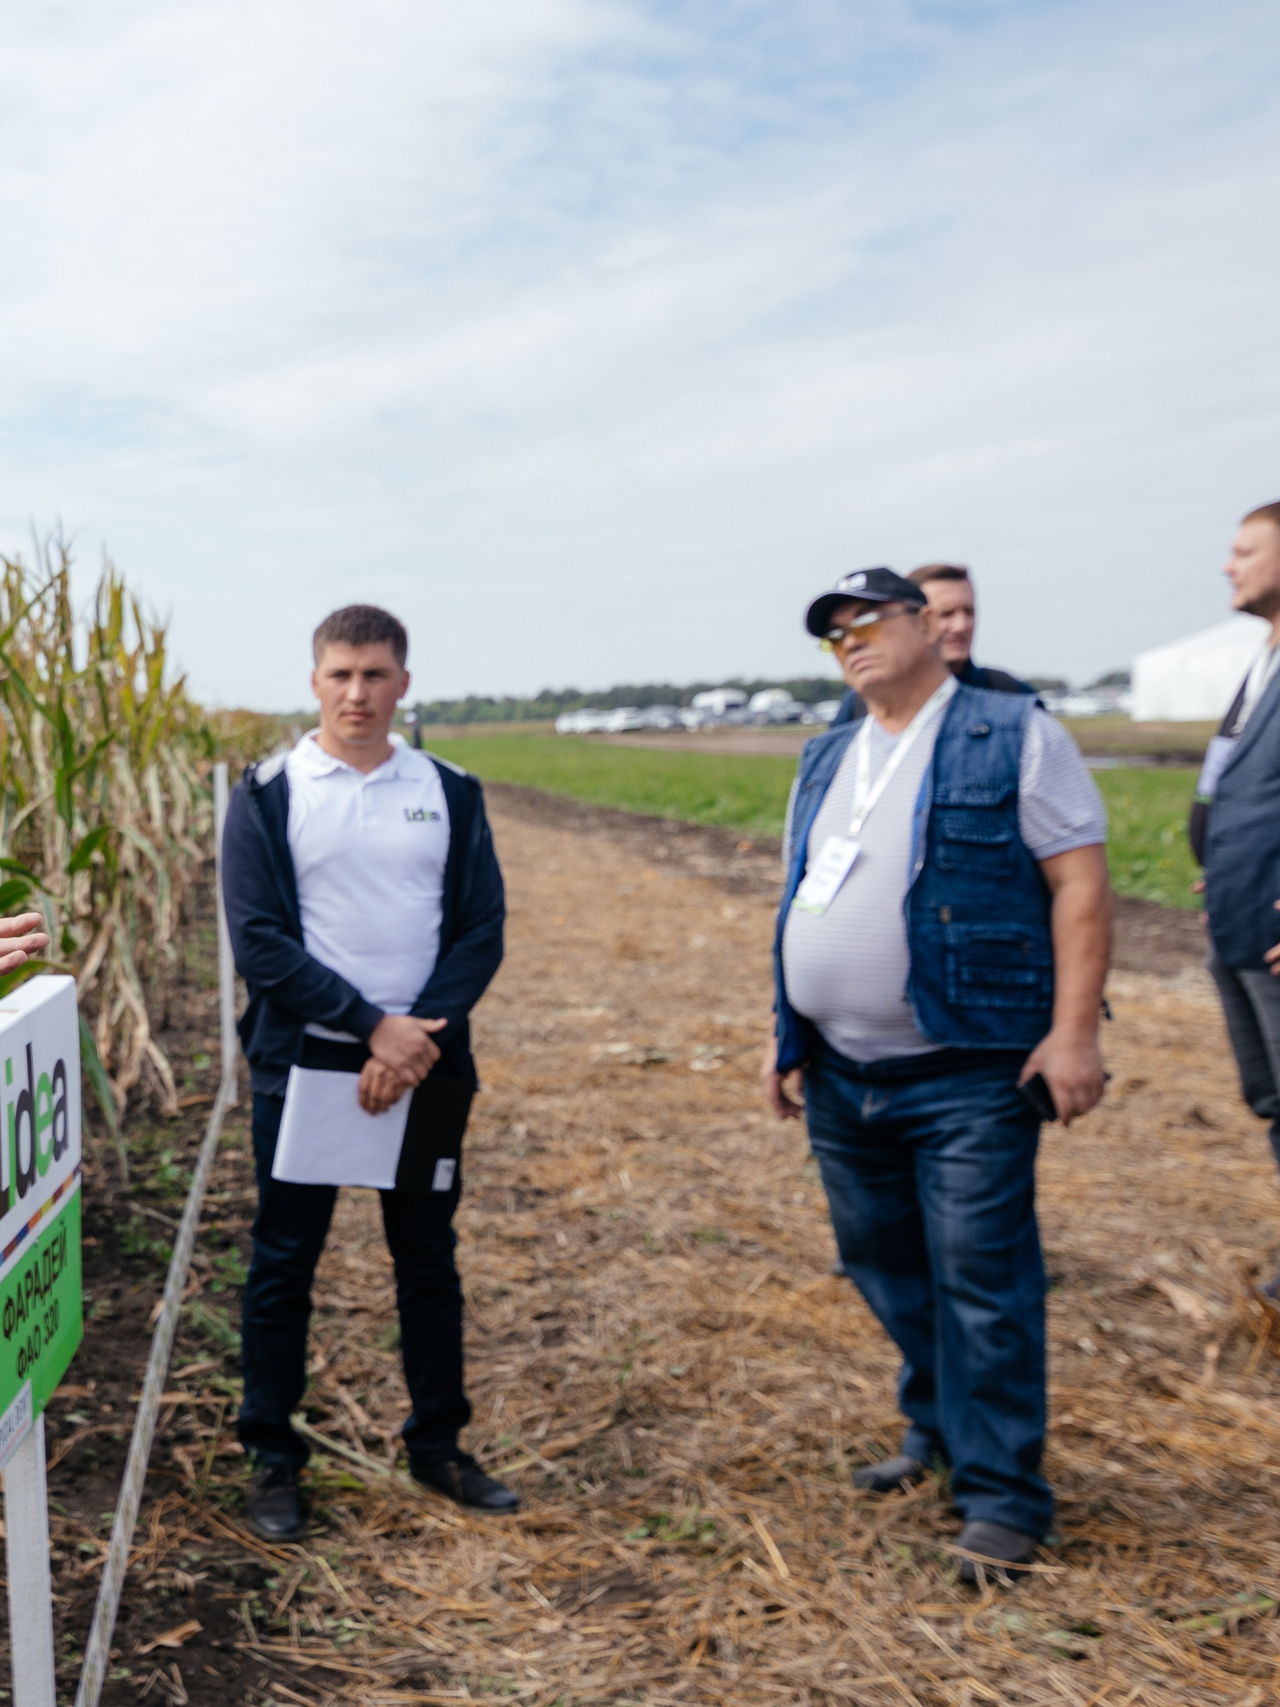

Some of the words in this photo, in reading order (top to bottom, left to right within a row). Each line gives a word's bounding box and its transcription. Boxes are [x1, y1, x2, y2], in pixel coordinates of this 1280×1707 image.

[2, 1219, 67, 1342] ФАРАДЕЙ
[16, 1324, 42, 1380] ФАО
[43, 1298, 60, 1346] 320
